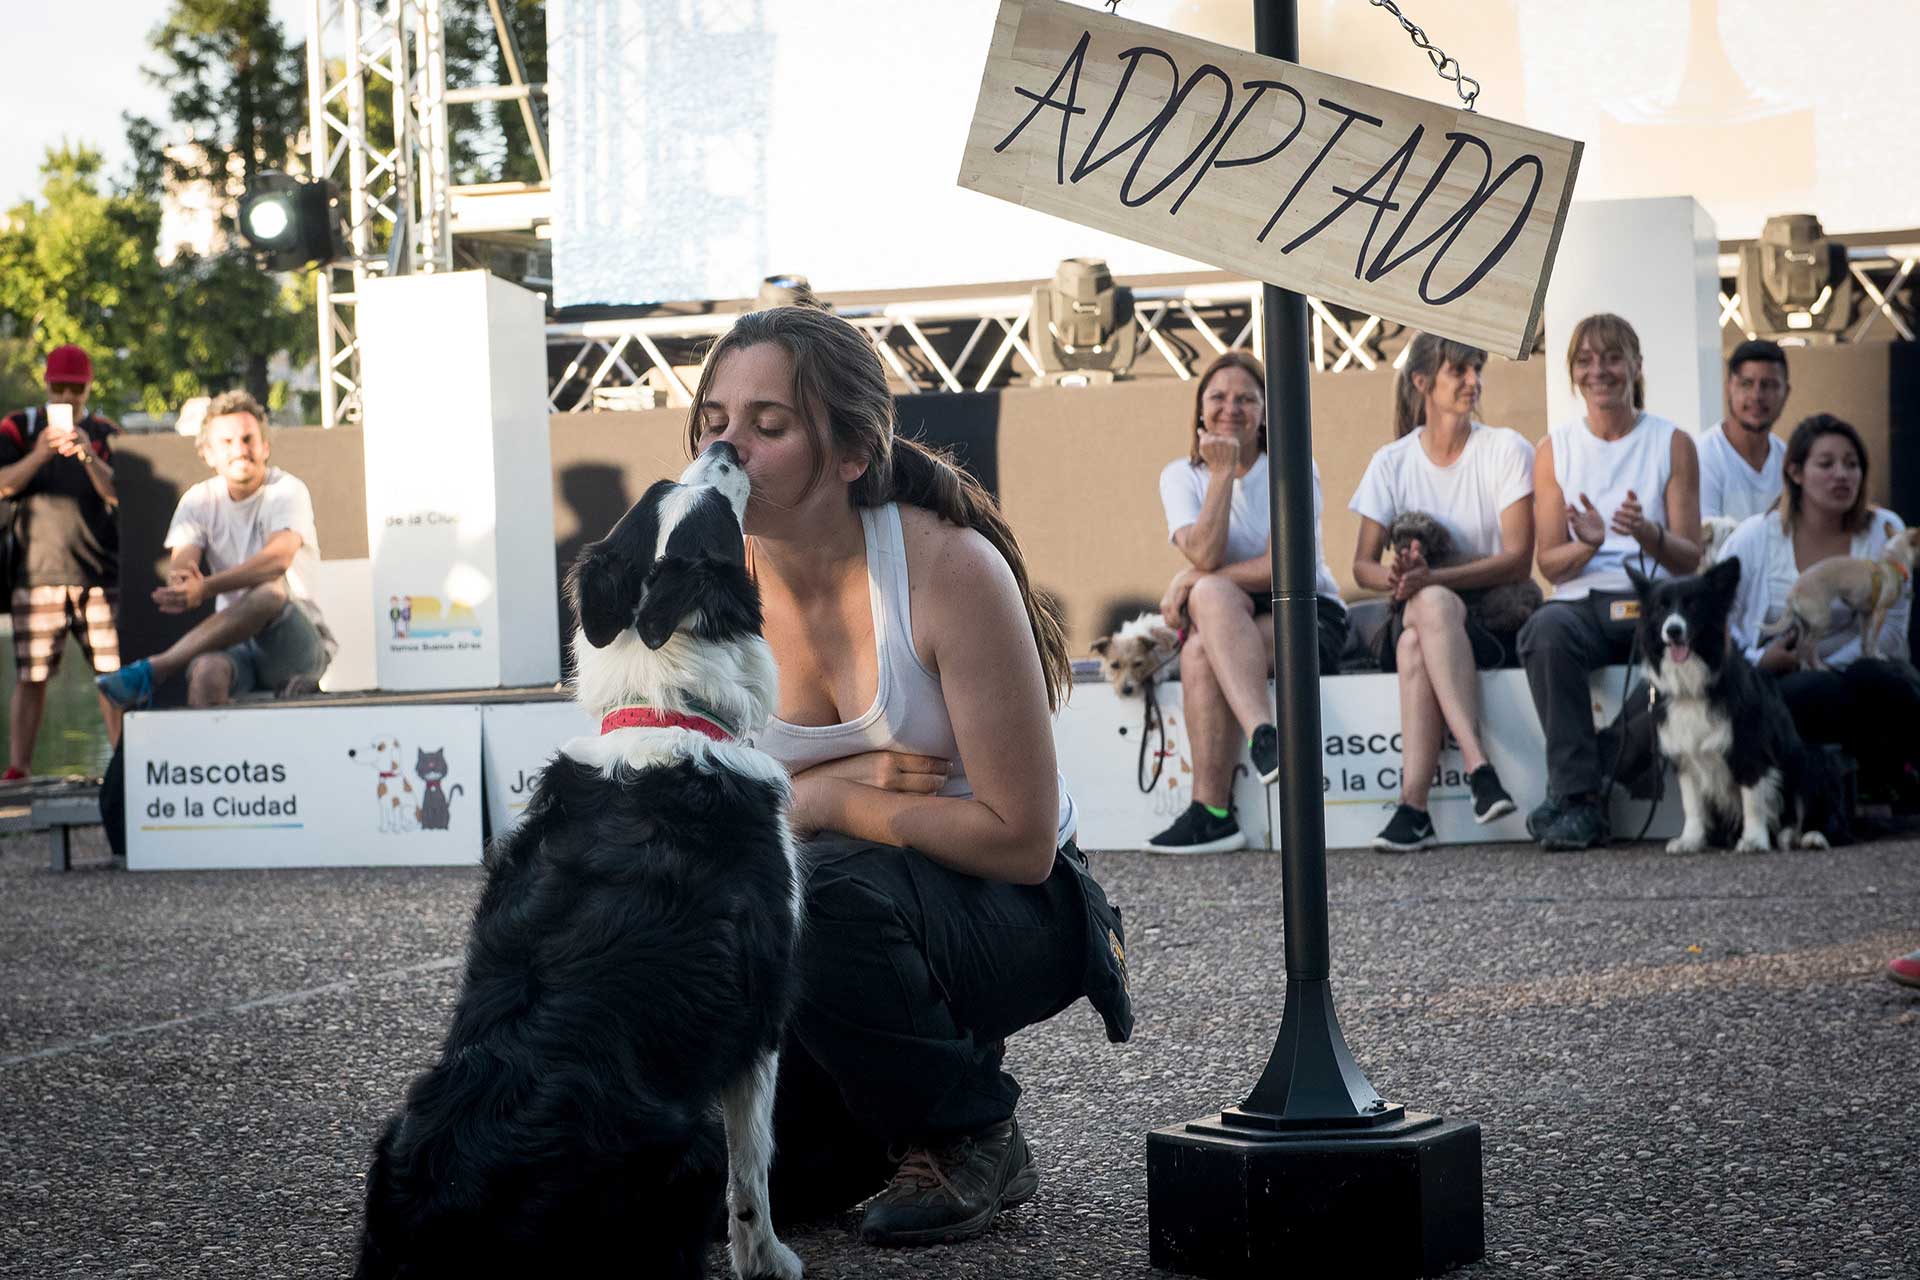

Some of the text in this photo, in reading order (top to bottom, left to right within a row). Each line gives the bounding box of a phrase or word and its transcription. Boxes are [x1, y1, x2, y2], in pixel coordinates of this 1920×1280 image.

[994, 30, 1543, 305] ADOPTADO
[146, 760, 287, 785] Mascotas
[511, 770, 540, 793] Jo
[1342, 768, 1366, 792] la
[147, 795, 297, 818] de la Ciudad
